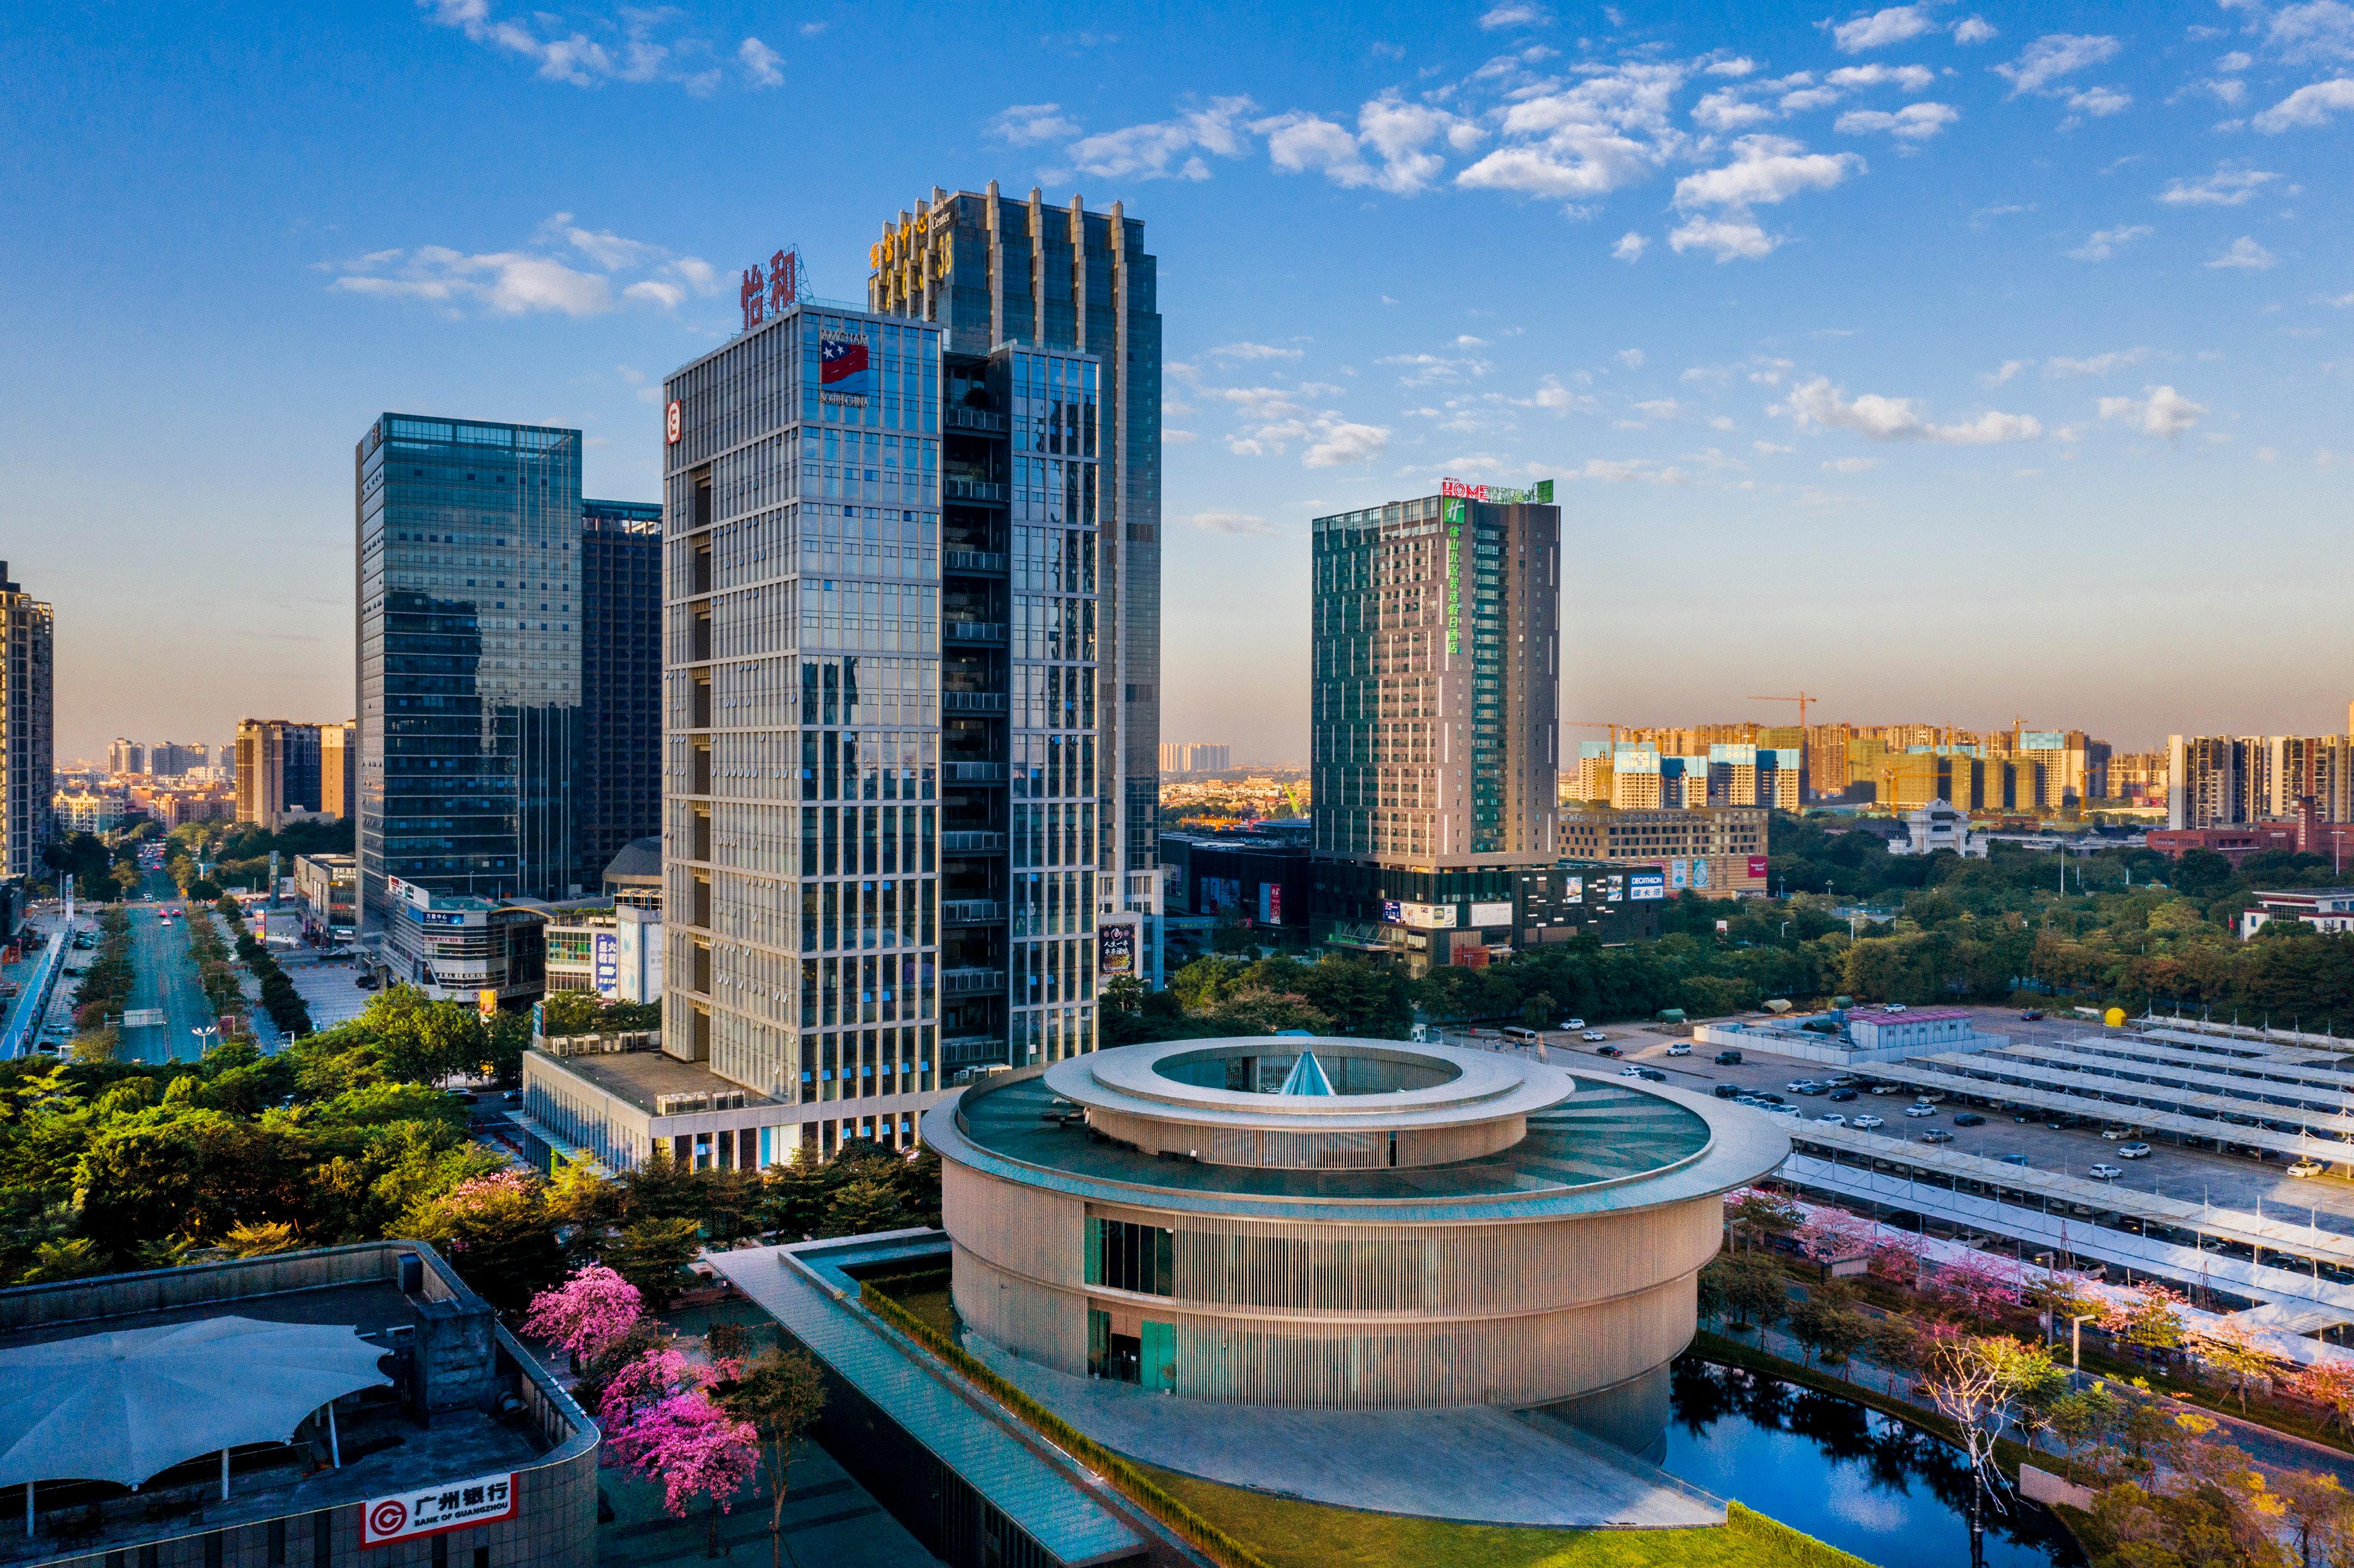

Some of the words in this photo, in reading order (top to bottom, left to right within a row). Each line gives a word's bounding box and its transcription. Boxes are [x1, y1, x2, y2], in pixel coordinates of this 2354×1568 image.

[932, 211, 950, 230] Center
[740, 249, 794, 330] 怡和
[821, 329, 869, 346] AMCHAM
[820, 392, 844, 405] SOUTH
[844, 395, 869, 407] CHINA
[1442, 481, 1488, 501] HOME
[415, 1482, 508, 1516] 广州银行
[414, 1516, 438, 1527] BANK
[455, 1502, 508, 1519] GUANGZHOU
